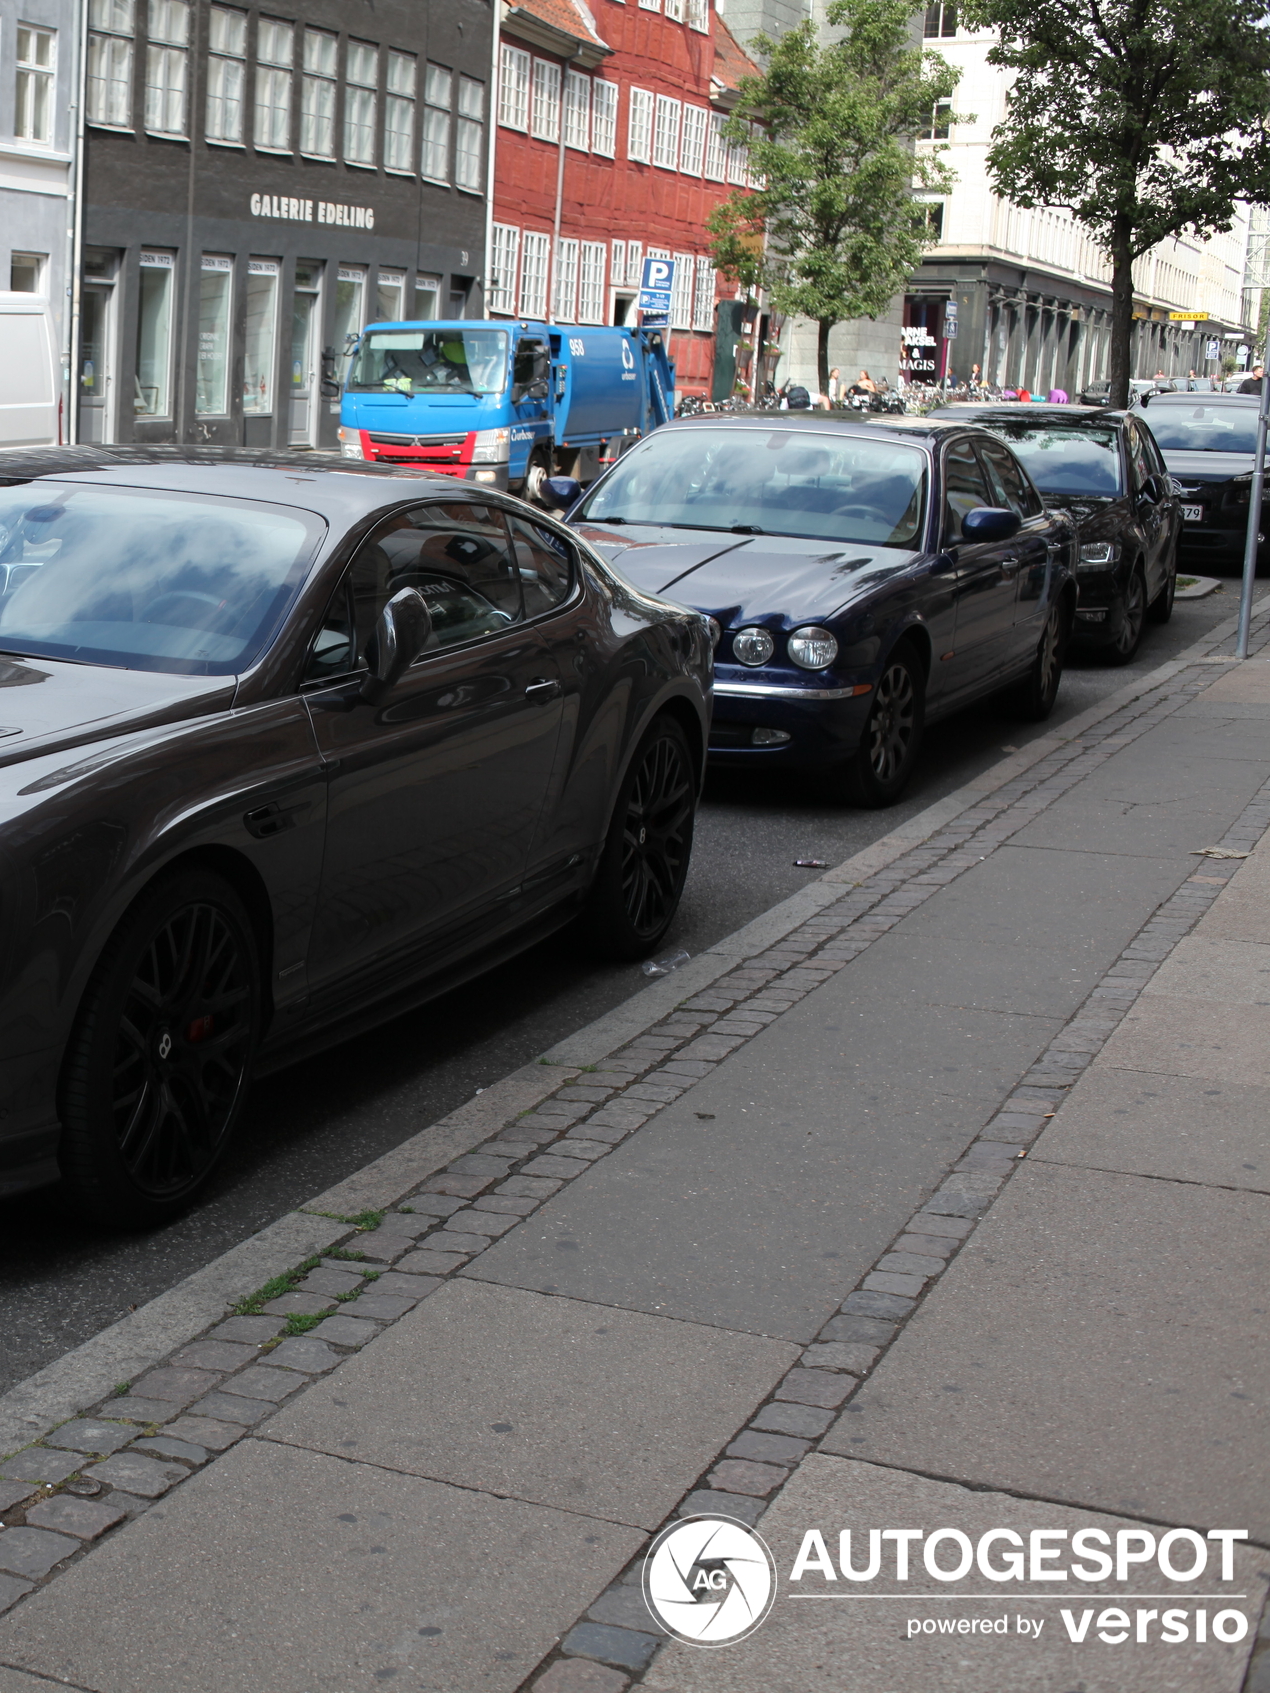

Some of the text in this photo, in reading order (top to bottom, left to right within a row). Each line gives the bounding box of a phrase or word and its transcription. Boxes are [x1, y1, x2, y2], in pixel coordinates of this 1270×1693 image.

[250, 193, 374, 230] GALERIE EDELING
[648, 262, 669, 288] P
[901, 326, 928, 337] ARNE
[904, 336, 937, 347] AKSEL
[570, 339, 584, 356] 958
[912, 348, 920, 358] &
[898, 360, 935, 371] MAGIS
